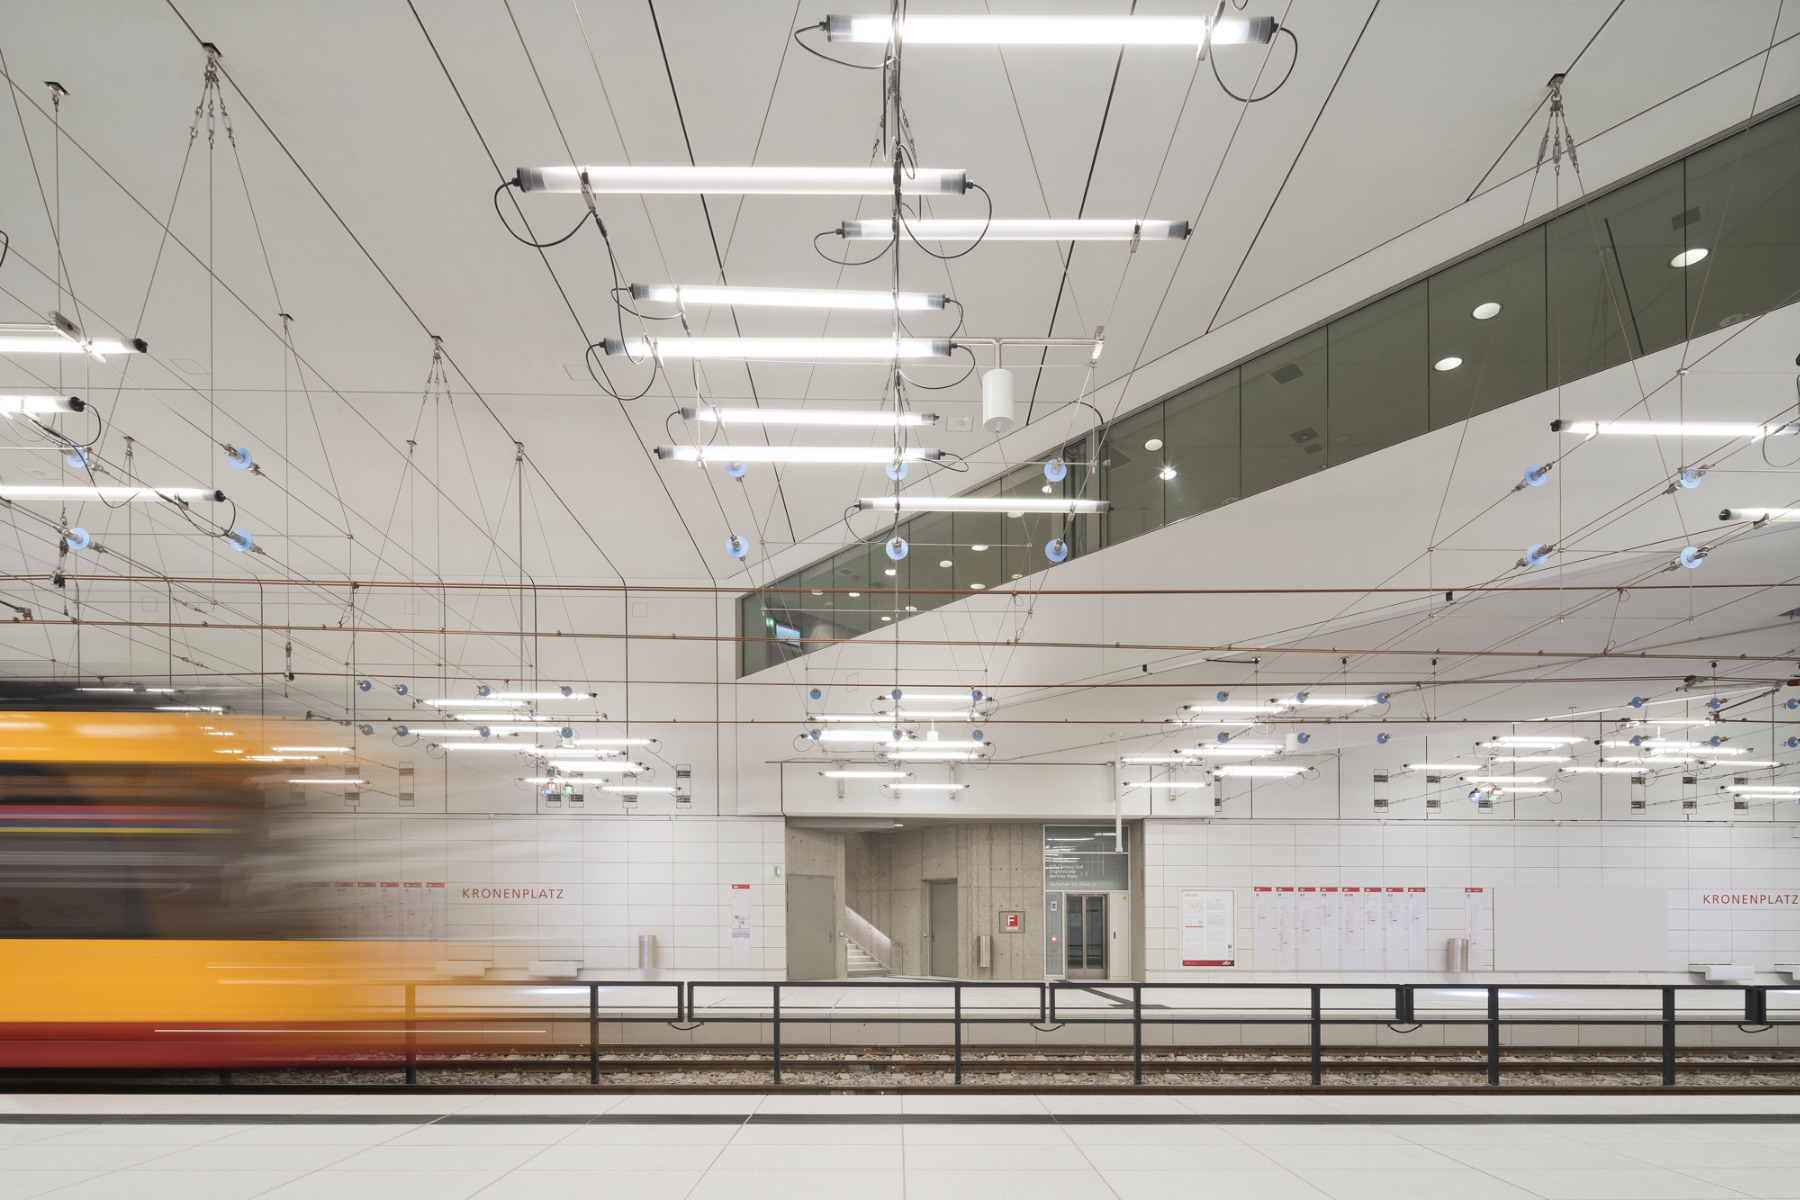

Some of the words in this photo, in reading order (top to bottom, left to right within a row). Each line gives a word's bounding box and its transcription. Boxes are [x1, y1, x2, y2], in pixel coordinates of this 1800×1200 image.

[462, 888, 564, 899] KRONENPLATZ
[1703, 894, 1799, 905] KRONENPLATZ
[1007, 915, 1016, 926] F
